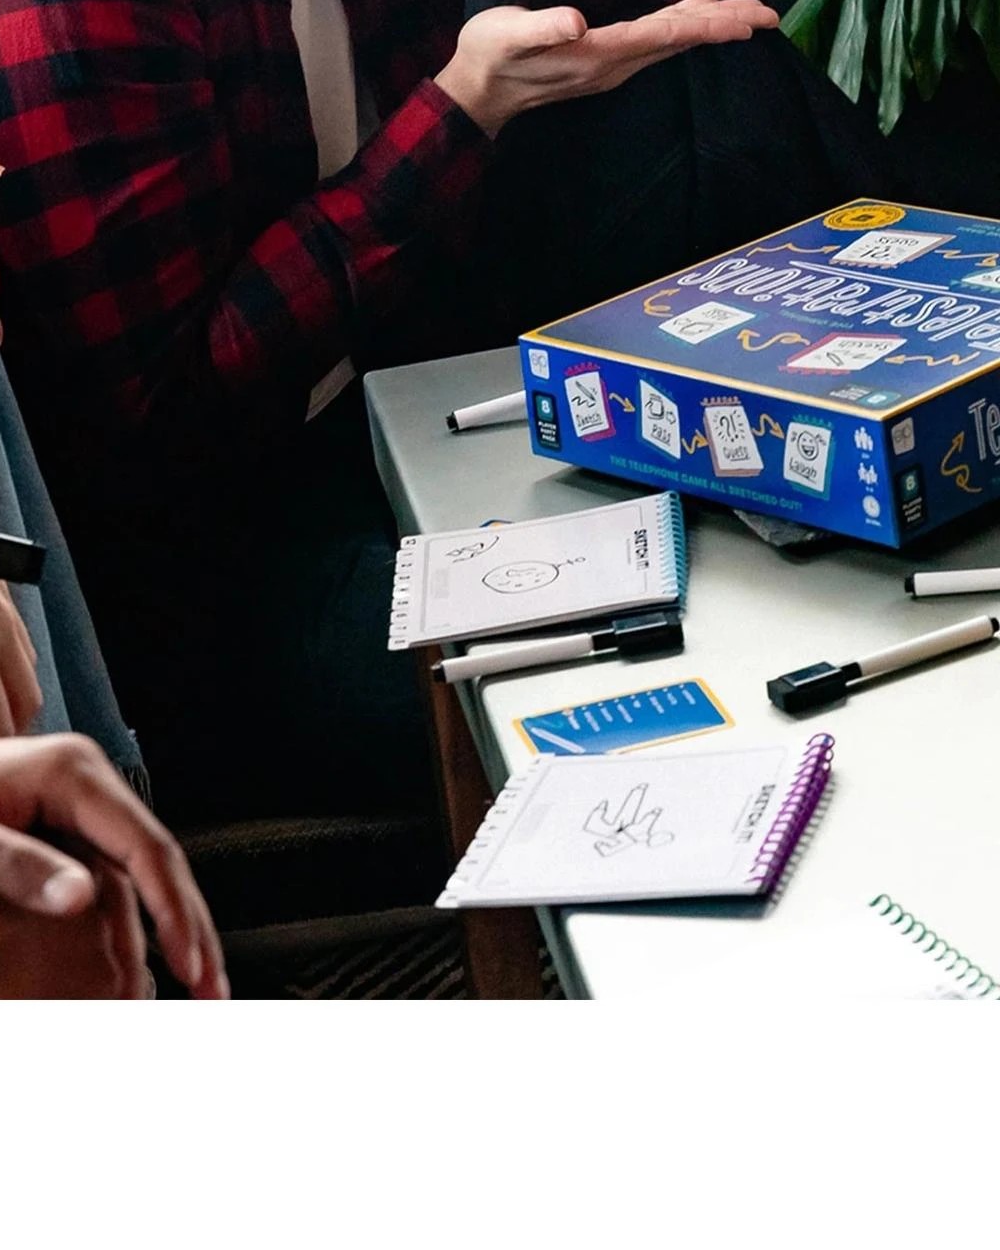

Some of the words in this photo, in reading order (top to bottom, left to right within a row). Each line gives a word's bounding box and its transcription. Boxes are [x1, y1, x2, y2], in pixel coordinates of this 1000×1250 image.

[628, 459, 679, 483] TELEPHONE
[681, 472, 708, 489] GAME
[710, 480, 726, 494] ALL
[728, 485, 778, 506] SKETCHED
